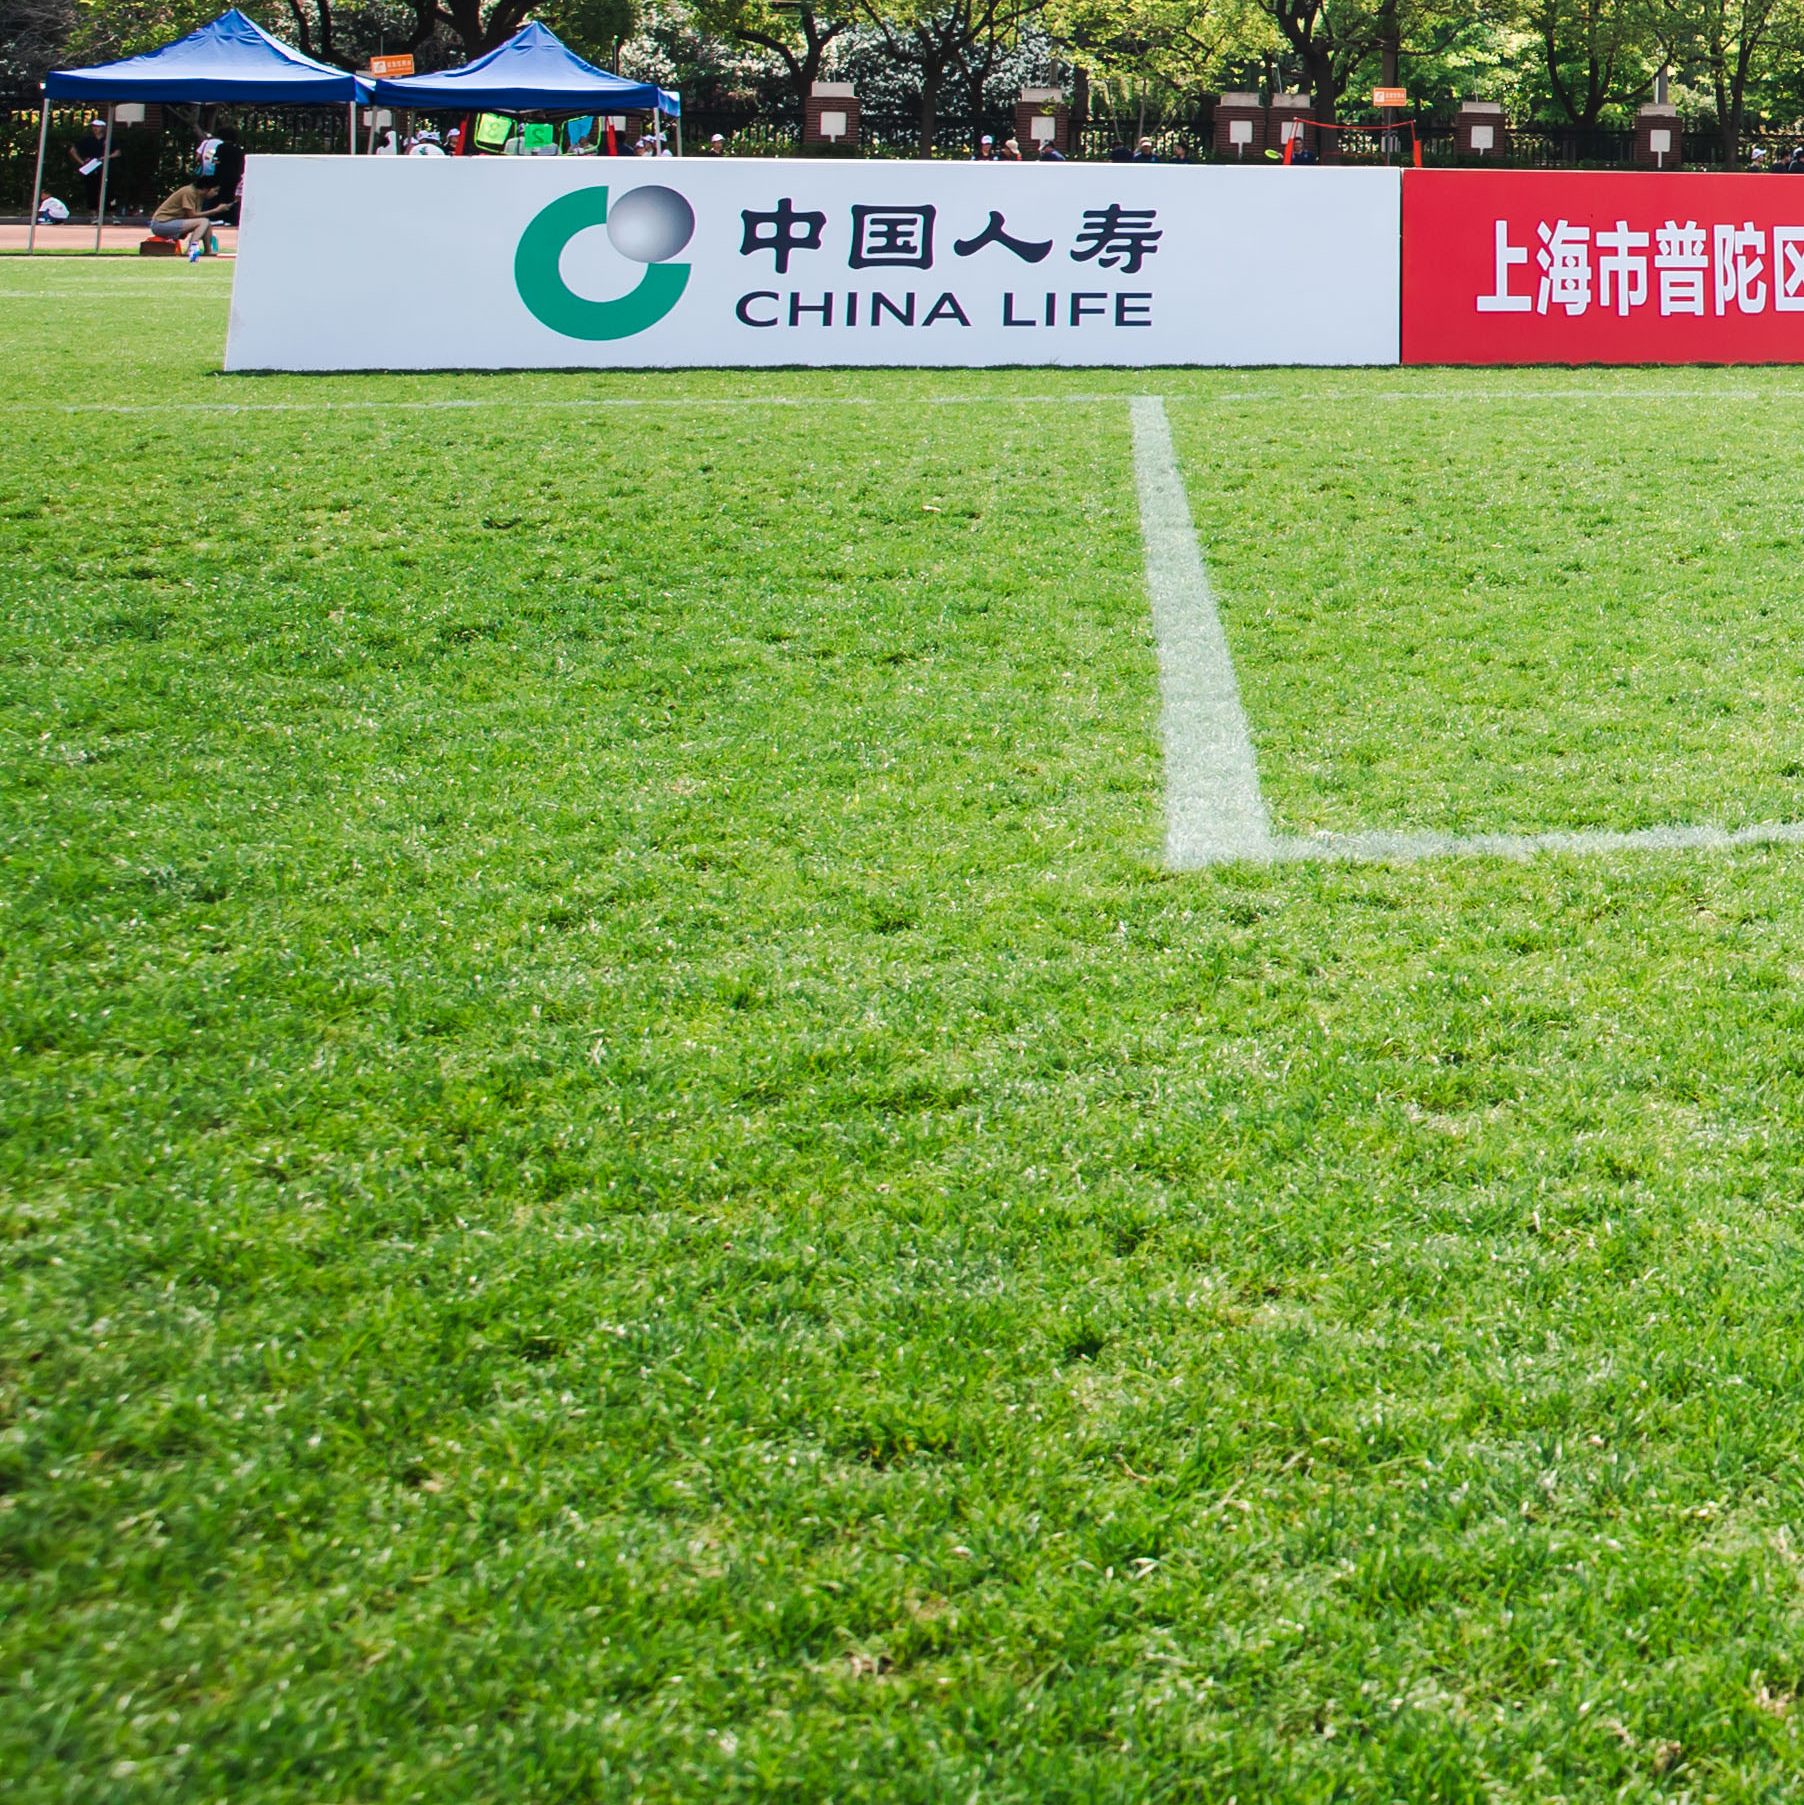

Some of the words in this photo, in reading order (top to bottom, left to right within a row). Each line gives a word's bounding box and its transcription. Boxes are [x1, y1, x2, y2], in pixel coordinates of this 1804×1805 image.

[740, 197, 1163, 274] 中国人寿
[735, 291, 970, 328] CHINA
[1003, 292, 1153, 327] LIFE
